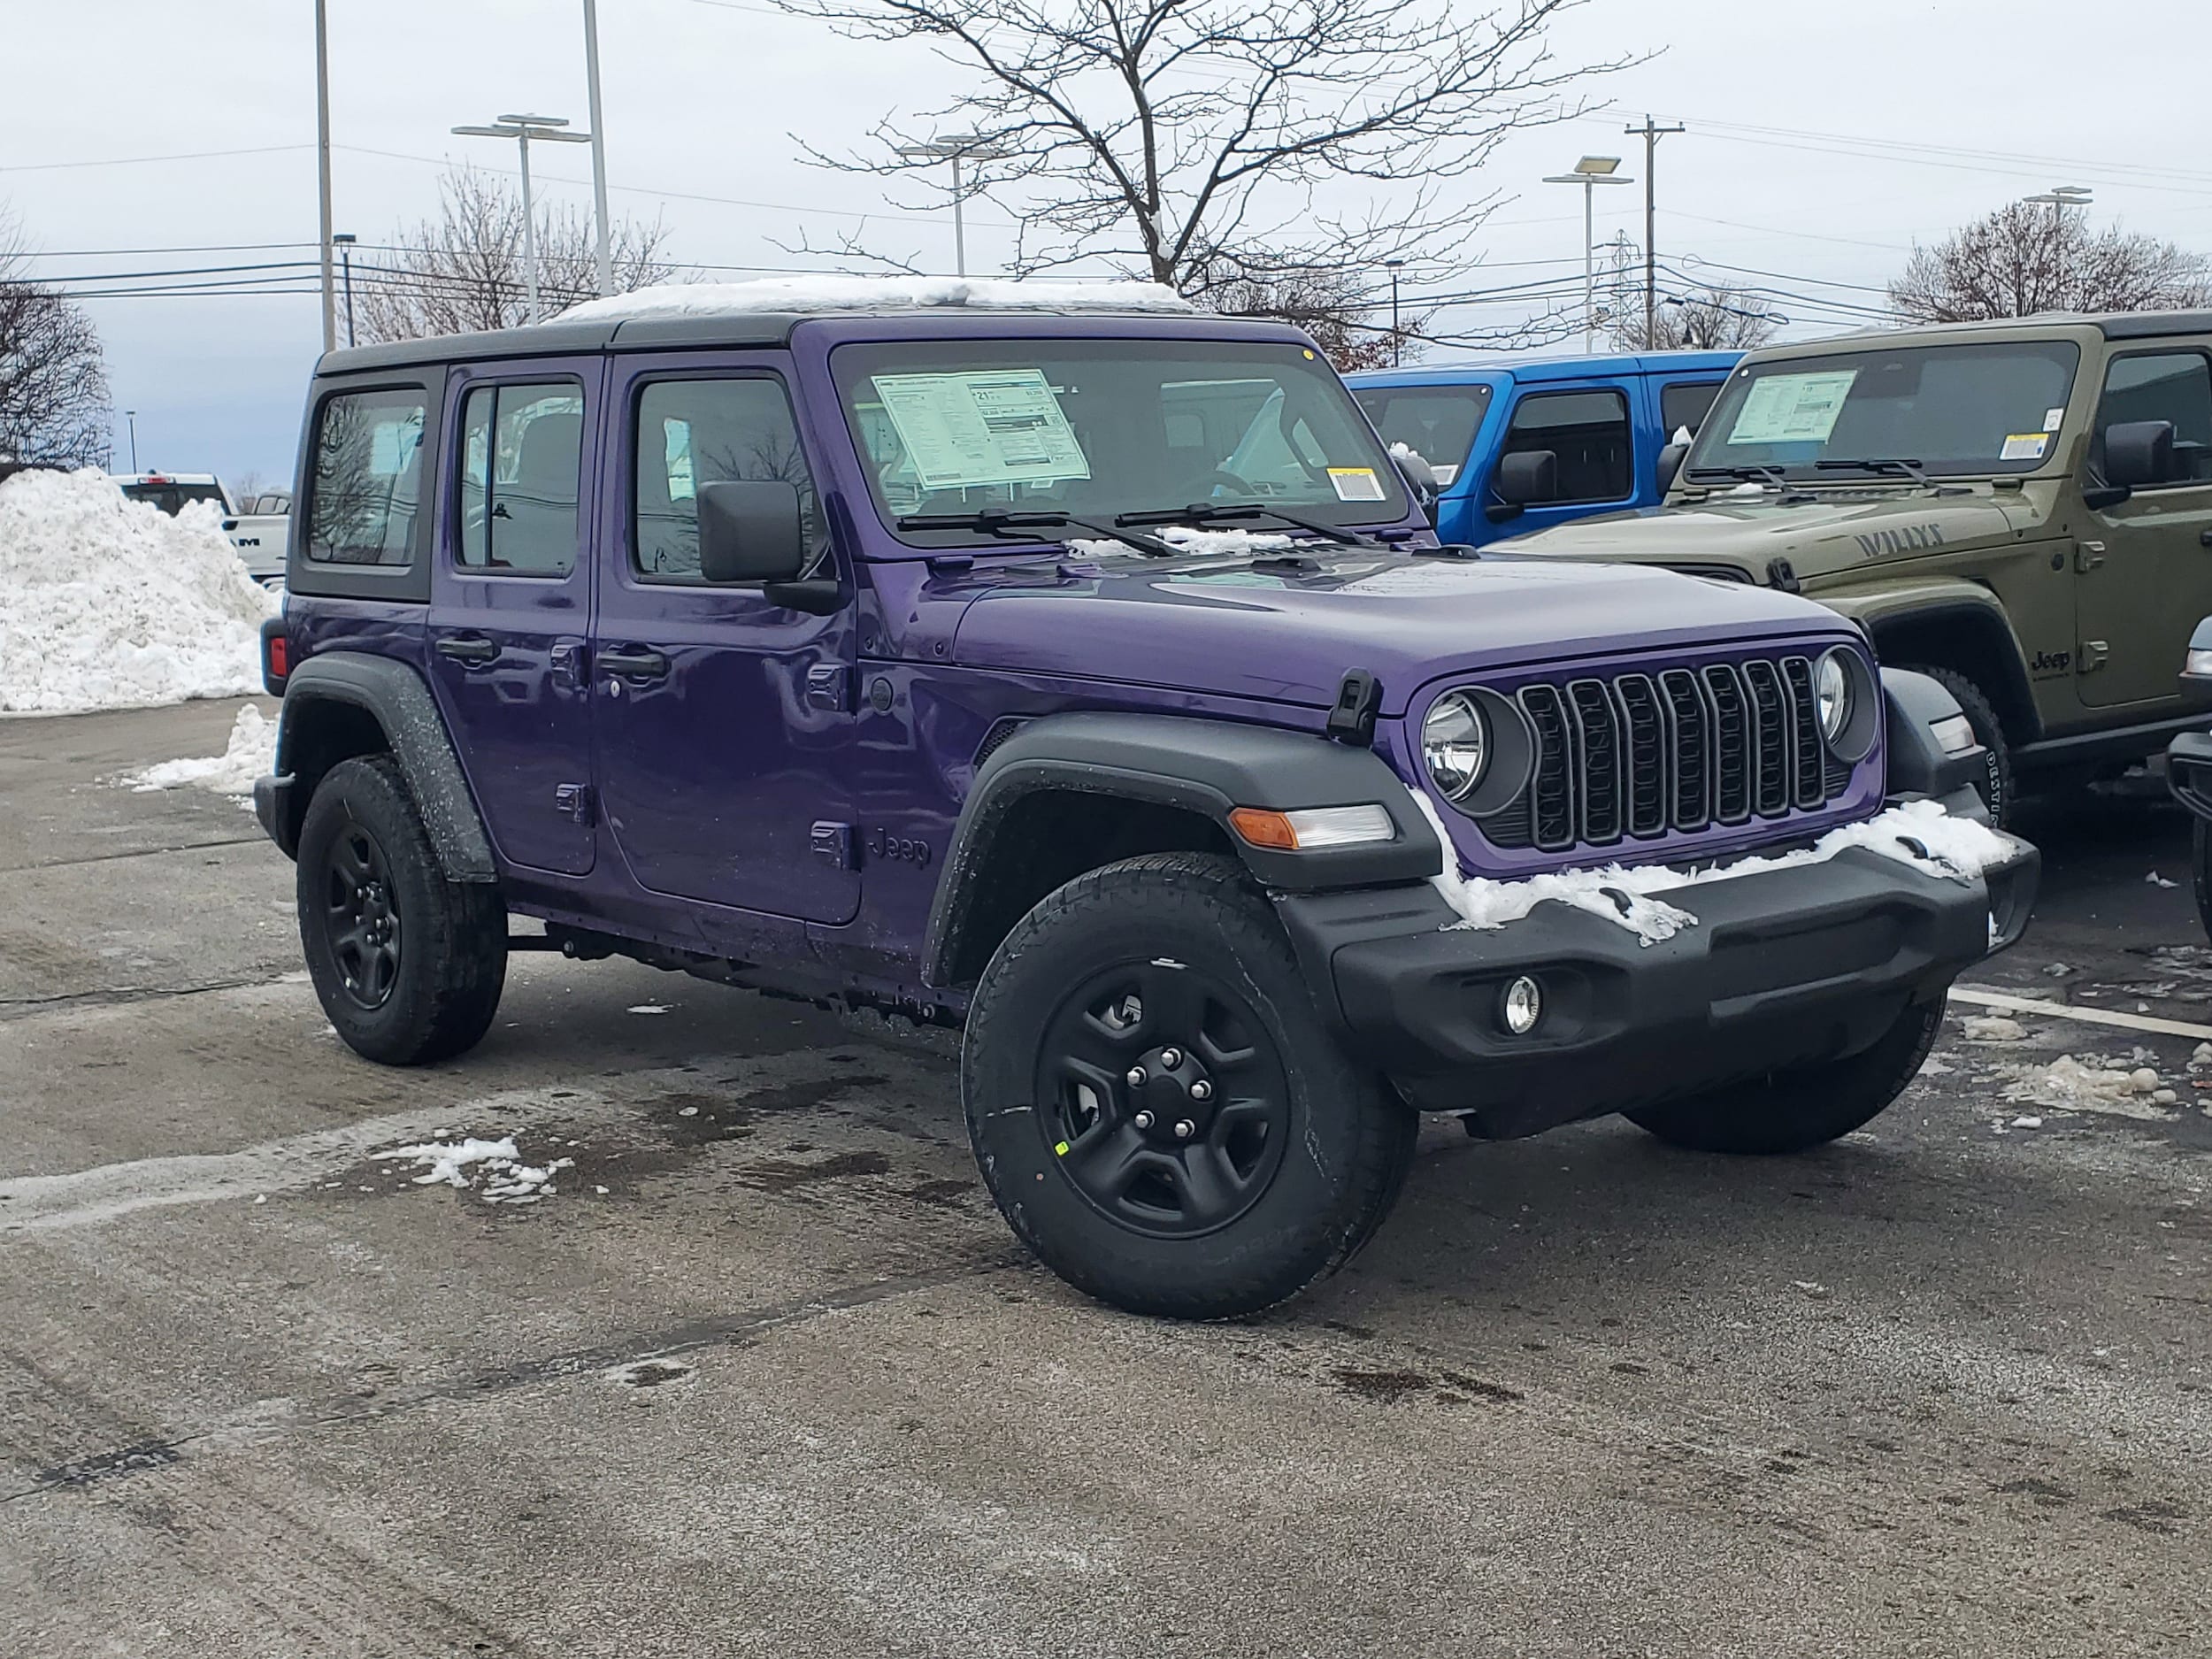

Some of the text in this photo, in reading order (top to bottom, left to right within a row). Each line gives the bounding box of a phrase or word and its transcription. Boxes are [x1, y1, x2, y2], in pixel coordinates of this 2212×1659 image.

[1854, 523, 1944, 557] WILLYS
[2032, 650, 2070, 671] Jeep
[867, 827, 932, 871] Jeep
